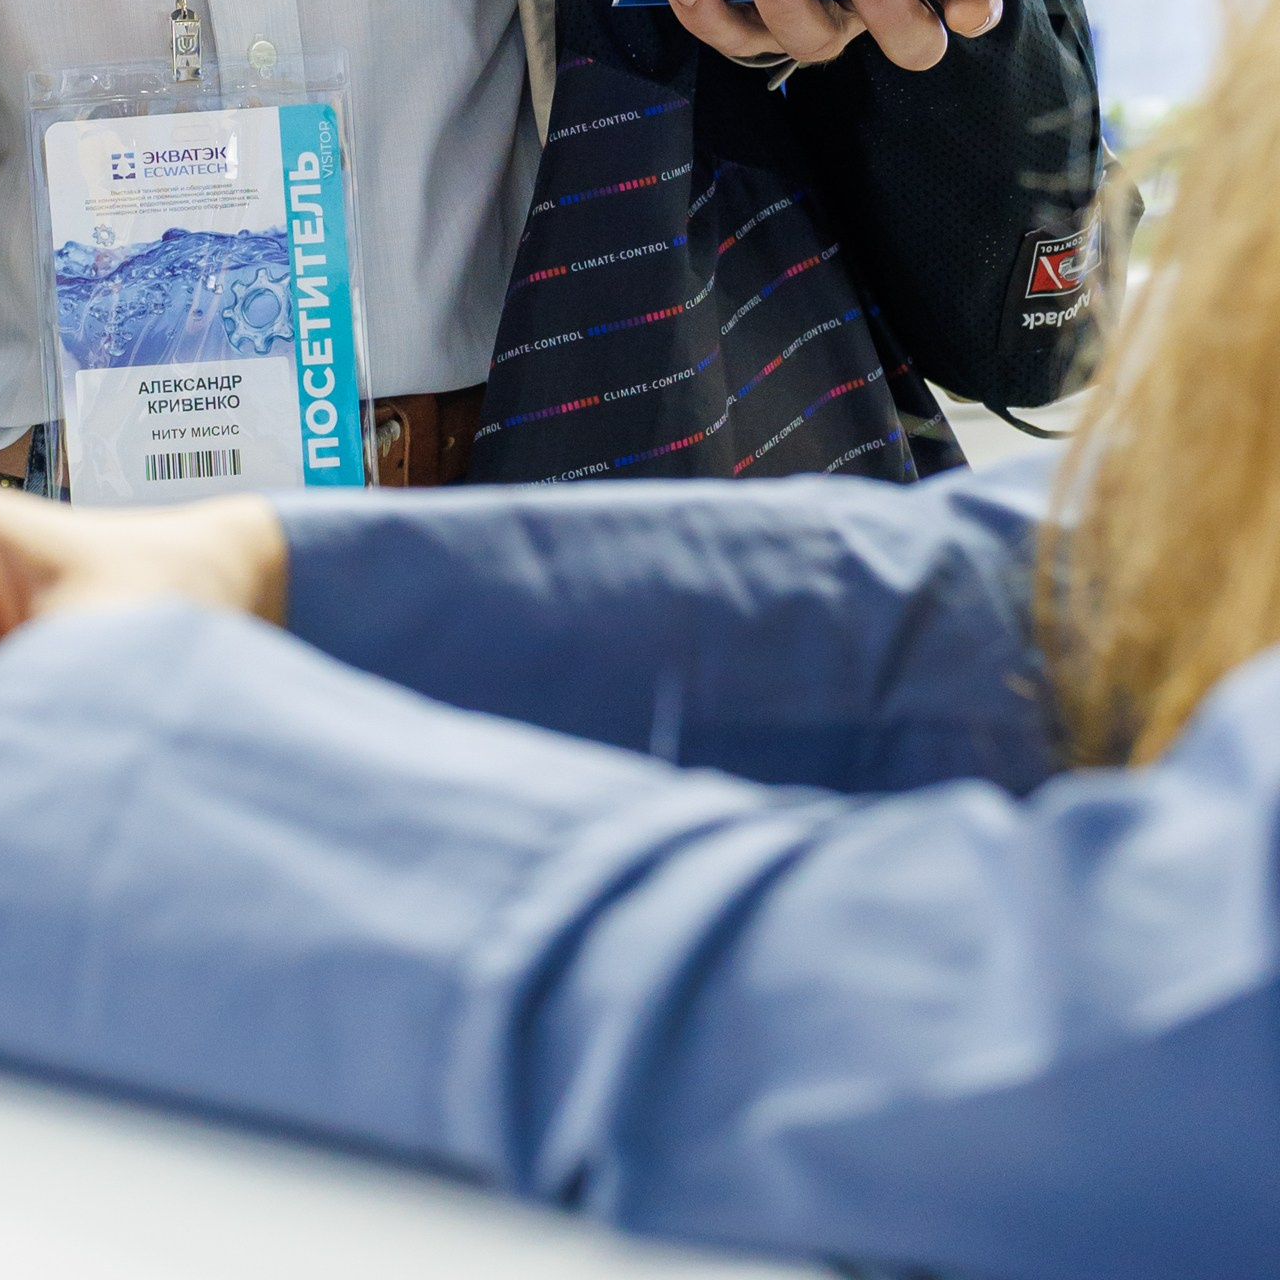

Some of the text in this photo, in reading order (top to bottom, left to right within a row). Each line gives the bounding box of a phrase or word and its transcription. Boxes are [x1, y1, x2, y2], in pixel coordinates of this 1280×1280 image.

[548, 110, 641, 143] CLIMATE-CONTROL
[142, 146, 227, 165] ЭКВАТЭК
[320, 120, 334, 179] VISITOR
[144, 163, 229, 179] ECWATECH
[661, 159, 694, 182] CLIMATE-
[735, 197, 793, 241] CLIMATE-CONTROL
[571, 241, 669, 272] CLIMATE-CONTROL
[288, 151, 341, 469] ПОСЕТИТЕЛЬ
[497, 331, 583, 364] CLIMATE-CONTROL
[782, 317, 842, 359] CLIMATE-CONTROL
[138, 374, 243, 396] АЛЕКСАНДР
[603, 367, 696, 402] CLIMATE-CONTROL
[147, 394, 241, 415] КРИВЕНКО
[151, 423, 240, 441] НИТУ МИСИС
[755, 414, 804, 458] CLIMATE-CONTROL
